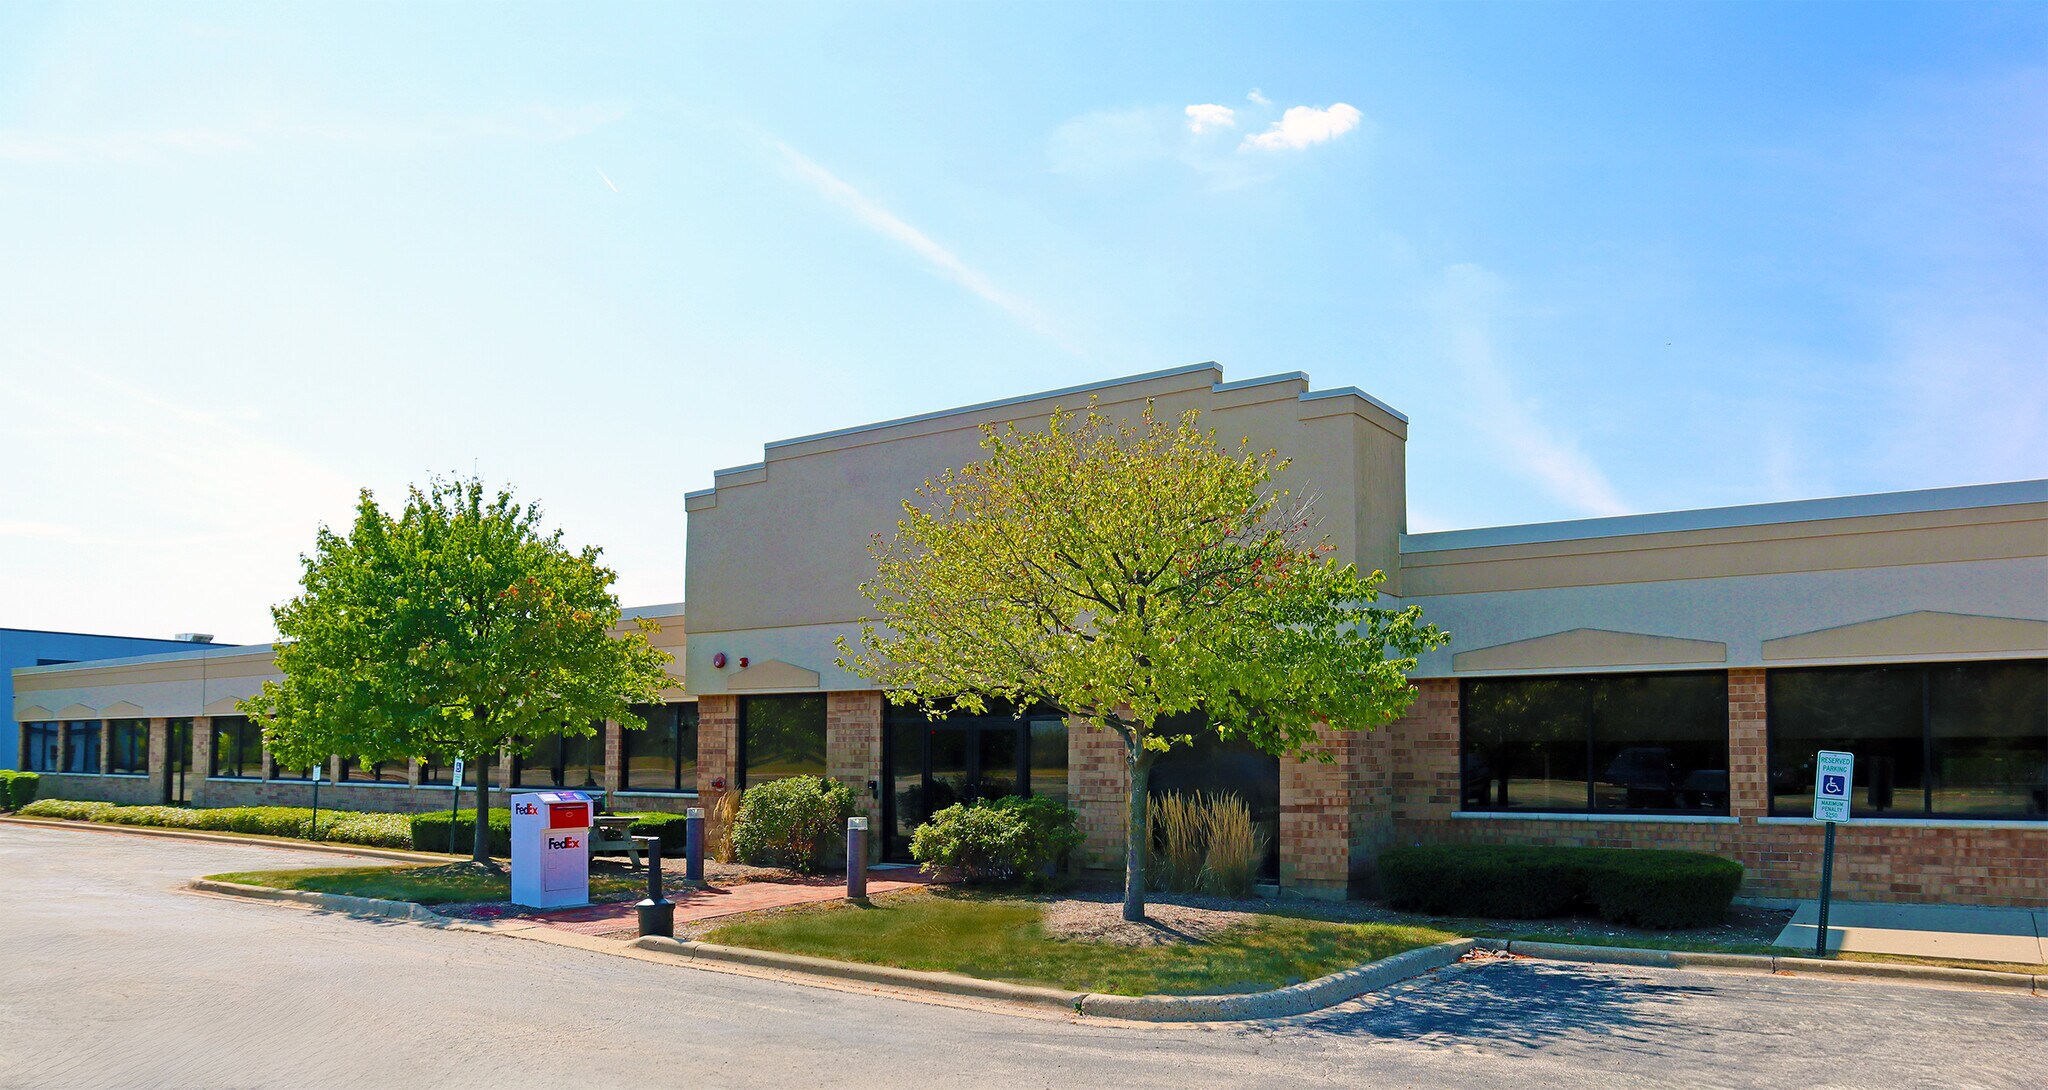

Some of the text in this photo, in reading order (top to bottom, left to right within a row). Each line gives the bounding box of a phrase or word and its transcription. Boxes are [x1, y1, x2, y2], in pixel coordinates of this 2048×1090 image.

[1821, 757, 1850, 765] RESERVED
[1823, 765, 1847, 773] PARKING
[516, 803, 538, 815] FedEx
[548, 837, 579, 850] FedEx
